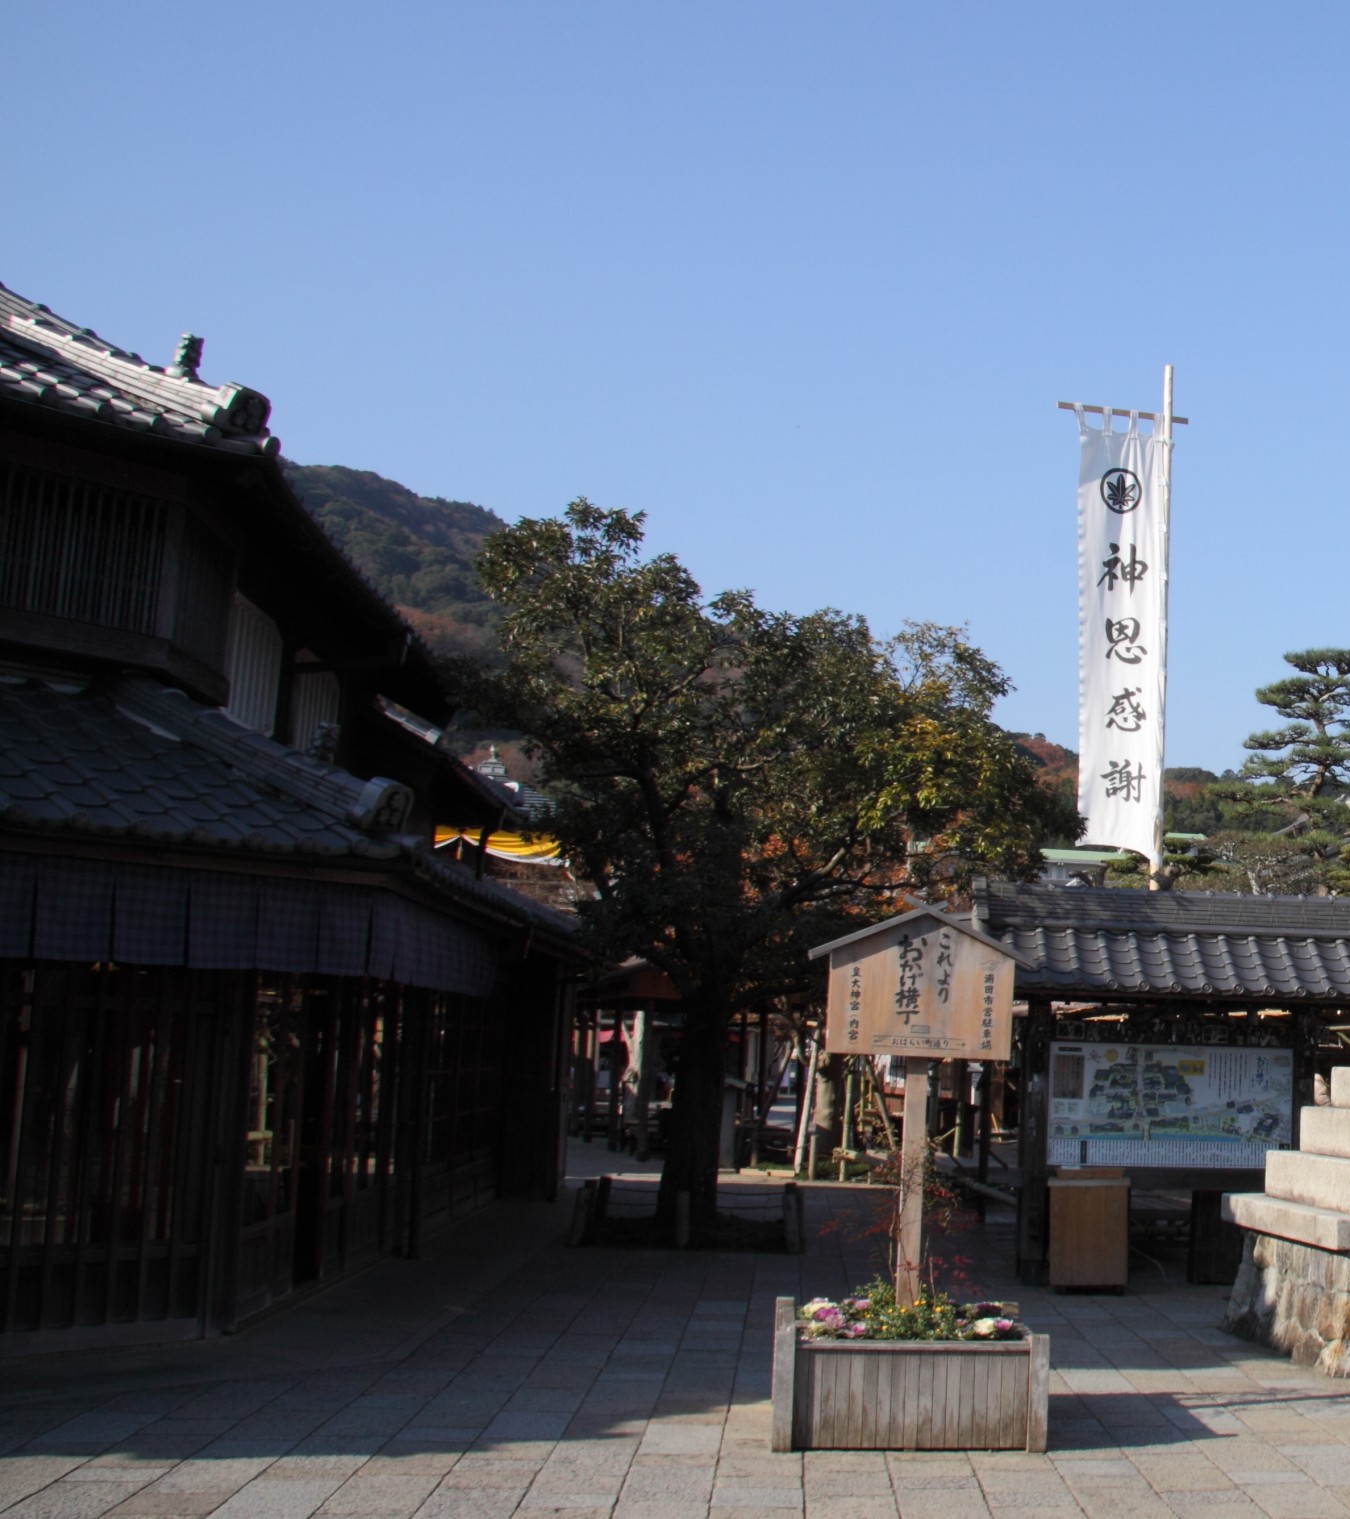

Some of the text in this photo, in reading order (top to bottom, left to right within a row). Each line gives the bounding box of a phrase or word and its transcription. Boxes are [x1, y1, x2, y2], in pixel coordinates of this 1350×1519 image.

[1096, 541, 1149, 805] 神恩感謝
[895, 934, 927, 1025] おかげ横丁
[936, 932, 954, 1004] これより
[891, 1037, 949, 1048] おはらい町通り
[980, 973, 994, 1051] 浦田市営駐車場
